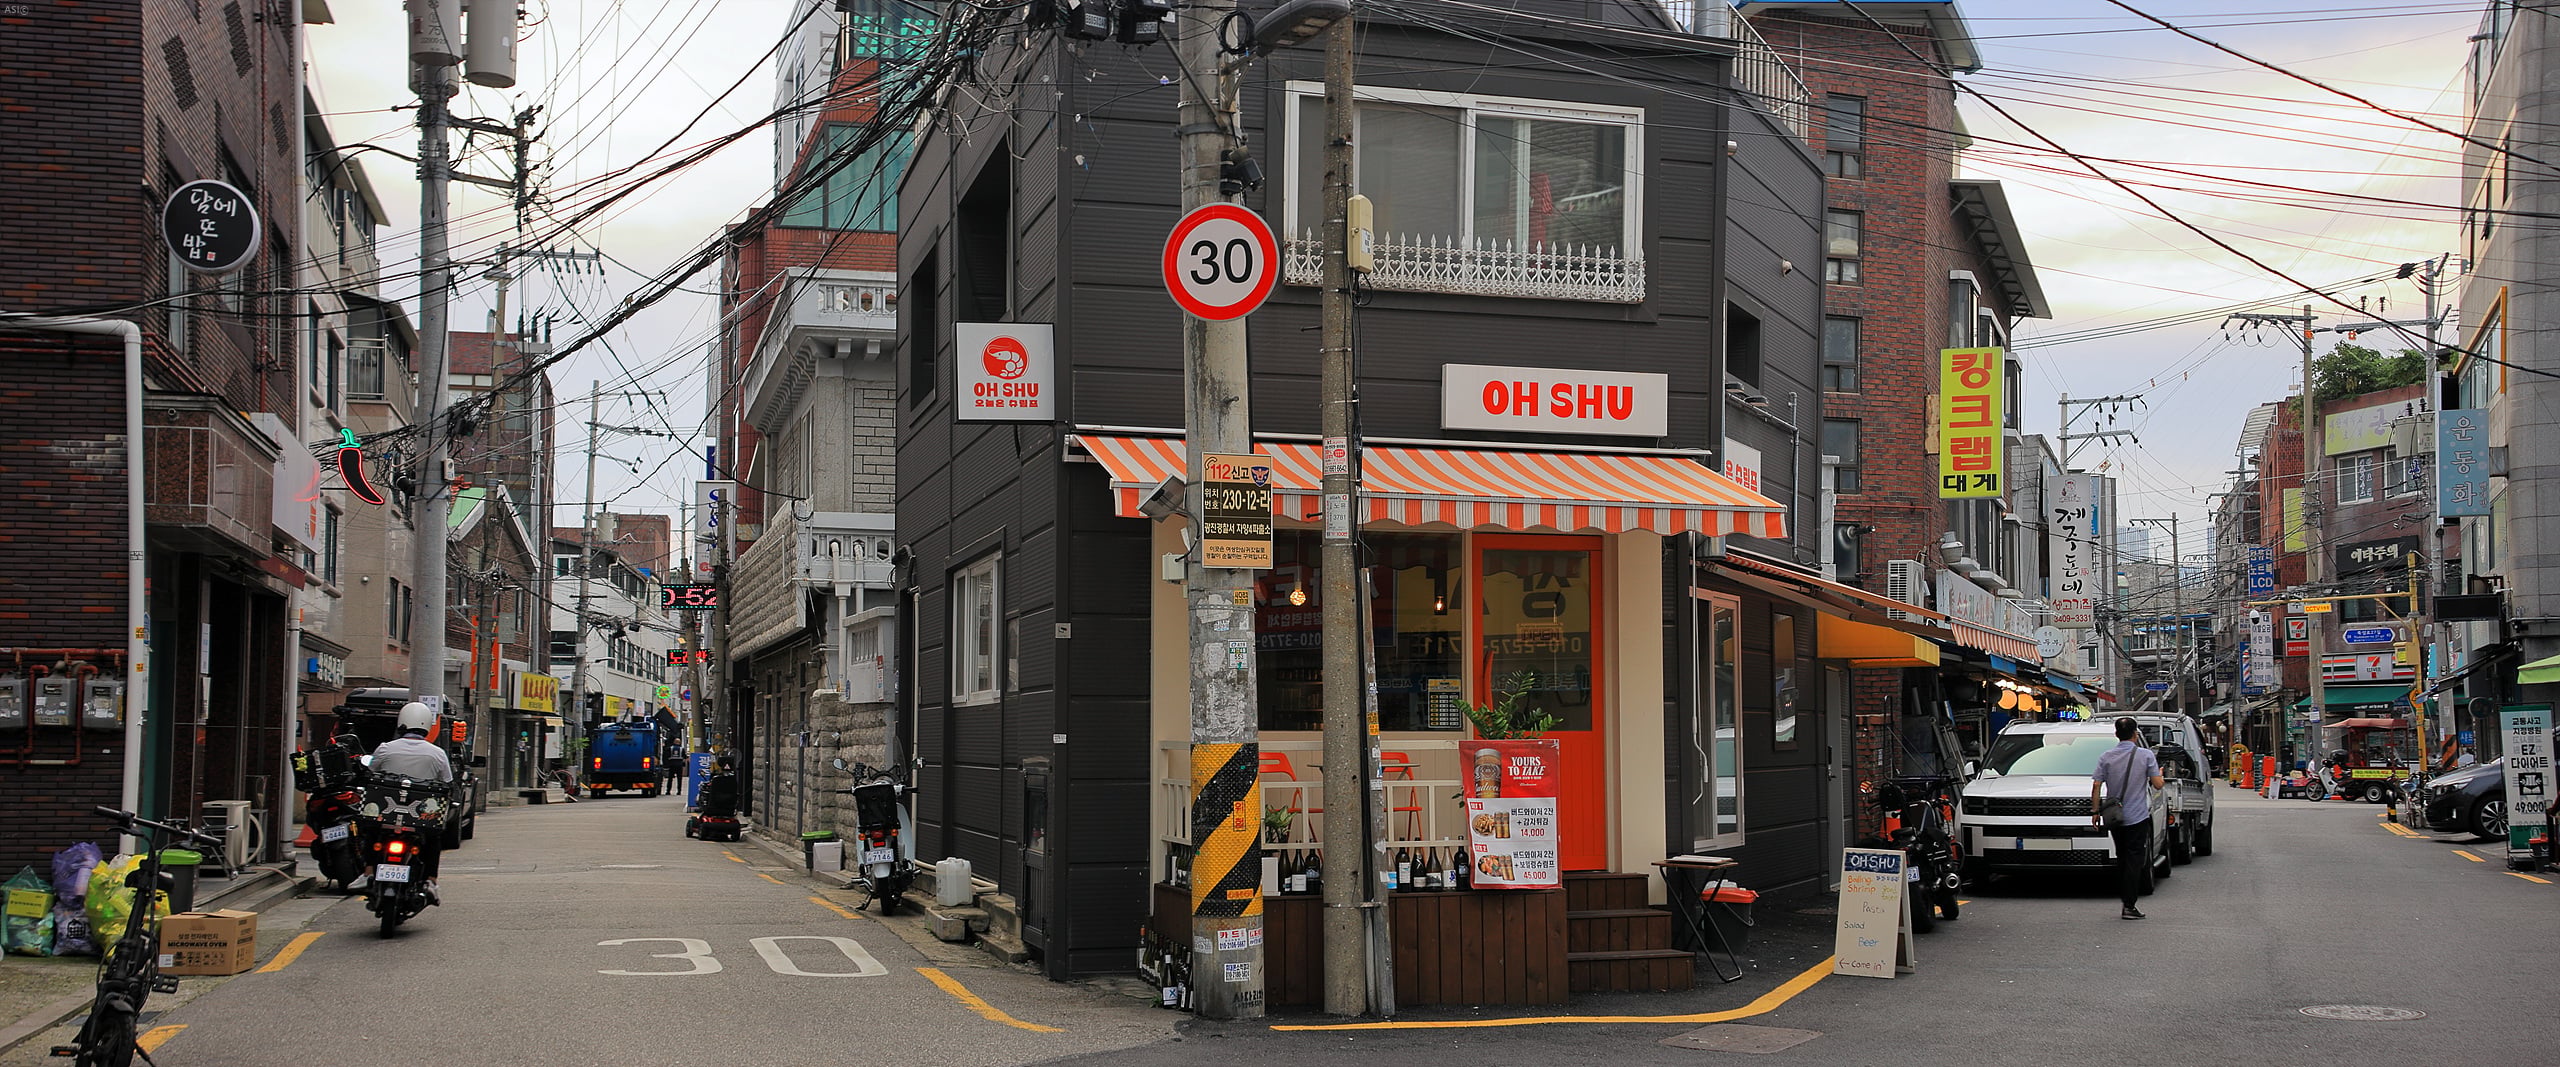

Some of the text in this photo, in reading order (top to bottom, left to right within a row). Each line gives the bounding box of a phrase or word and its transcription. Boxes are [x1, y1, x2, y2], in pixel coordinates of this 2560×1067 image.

[182, 233, 206, 259] 밥
[1189, 239, 1254, 285] 30
[974, 382, 1039, 398] OH SHU
[974, 399, 1005, 408] 오늘은
[1482, 380, 1633, 421] OH SHU
[1948, 352, 1994, 472] 킹크랩
[2450, 416, 2478, 506] 운동화
[1942, 473, 1997, 492] 대게
[1204, 488, 1220, 499] 위치
[1204, 501, 1220, 511] 번호
[1204, 522, 1236, 535] 광진경찰서
[2250, 577, 2273, 588] LCD
[2053, 613, 2092, 624] 3409-3331
[2511, 717, 2542, 726] 교통사고
[2521, 744, 2536, 756] EZ
[1511, 756, 1541, 772] YOURS
[2510, 757, 2549, 769] 다이어트
[1508, 766, 1546, 782] TO TAKE
[1234, 801, 1244, 830] 위험
[1520, 829, 1545, 838] 14,000
[872, 853, 893, 862] 7146
[384, 869, 407, 881] 5906
[1523, 871, 1547, 880] 45,000
[1847, 884, 1876, 895] Shrimp
[1844, 921, 1865, 930] Salad
[1858, 936, 1879, 948] Beer
[597, 935, 889, 977] 30
